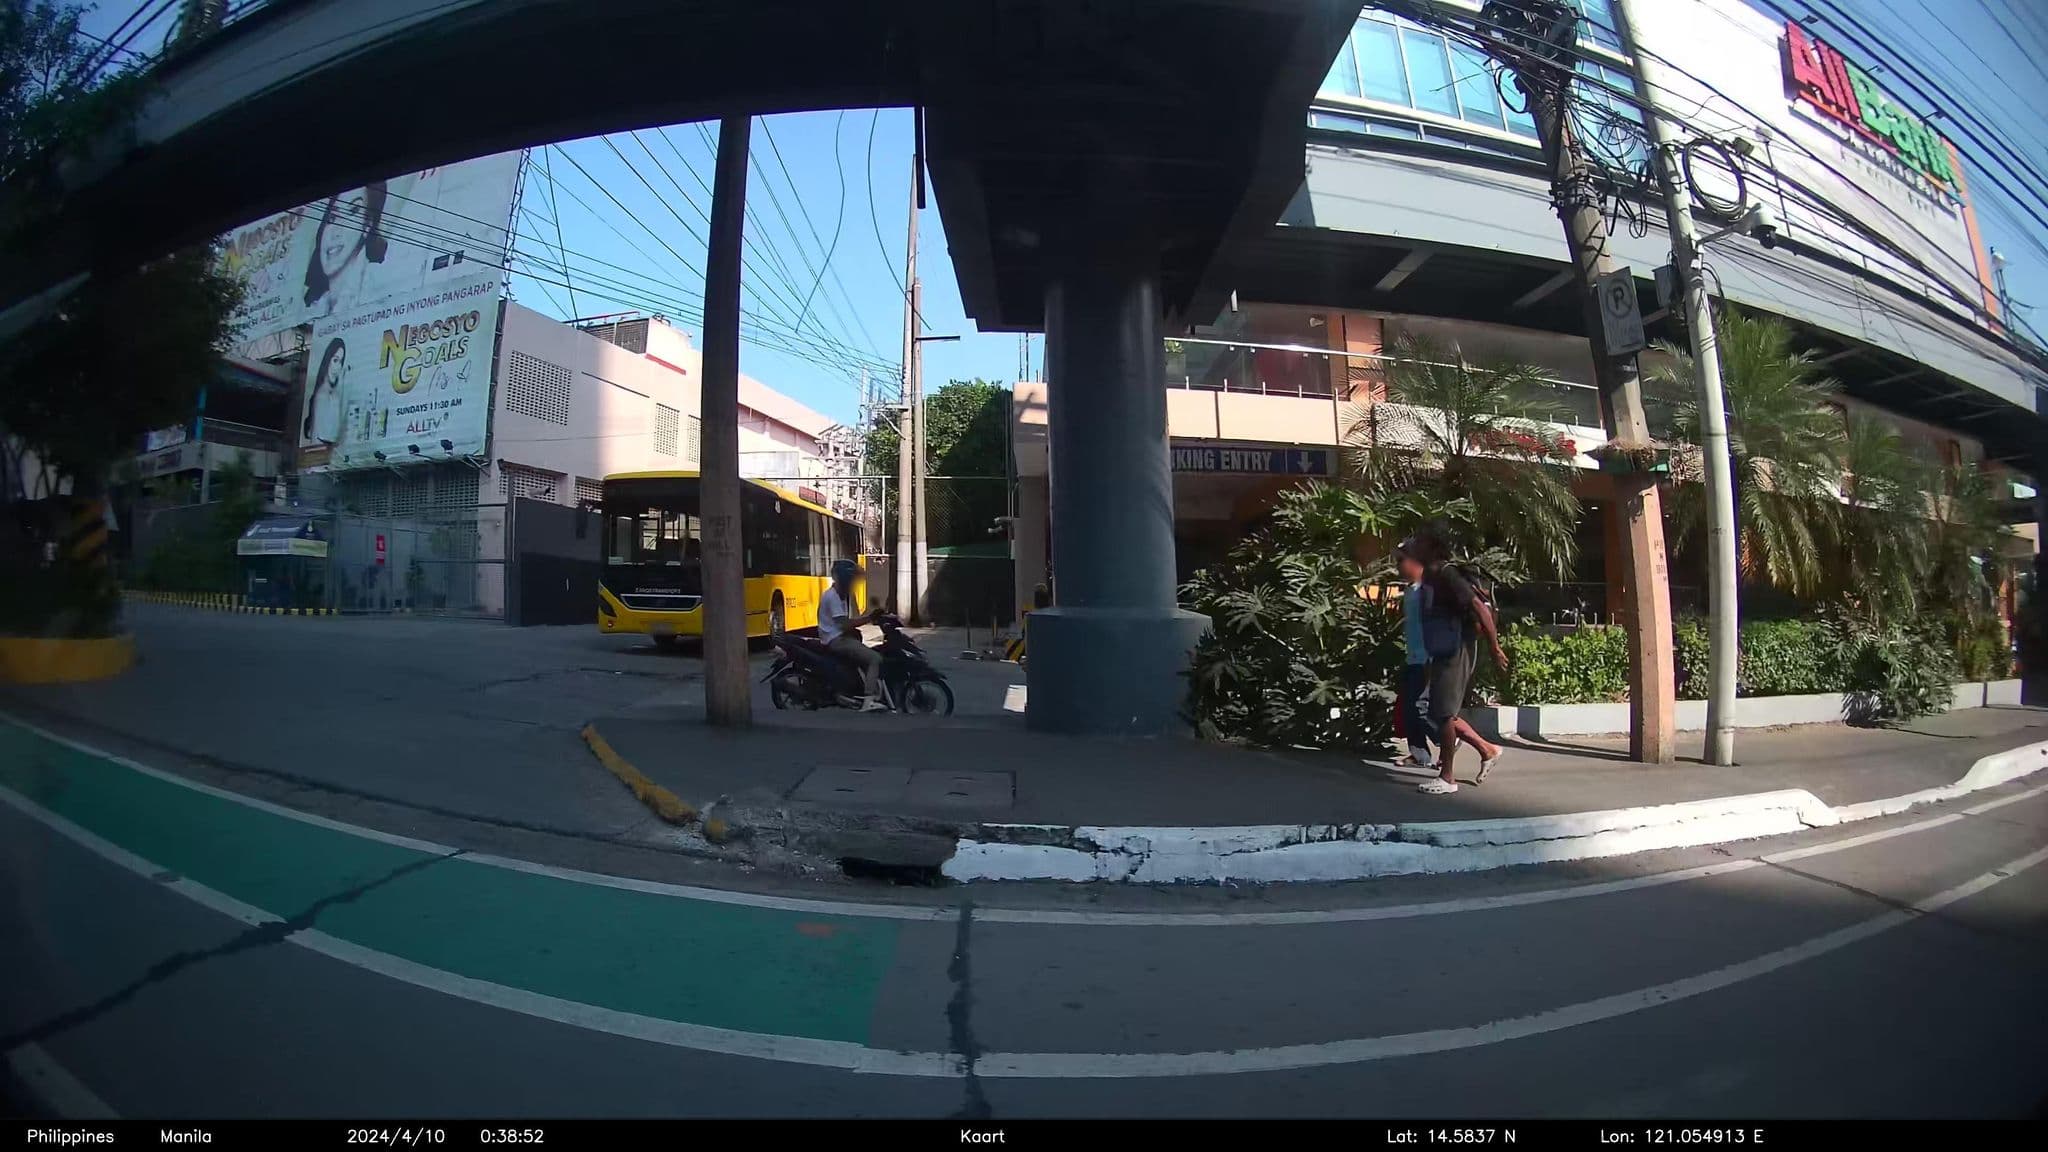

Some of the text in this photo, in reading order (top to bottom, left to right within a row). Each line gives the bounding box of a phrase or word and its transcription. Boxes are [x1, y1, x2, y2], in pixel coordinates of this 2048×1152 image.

[406, 294, 440, 314] INYONG
[441, 281, 494, 303] PANGARAP
[379, 310, 481, 369] NEGOSYO
[392, 335, 470, 394] GOALS
[396, 398, 462, 416] SUNDAYS 11:30 AM
[406, 416, 442, 434] ALLTV
[1220, 450, 1272, 472] ENTRY
